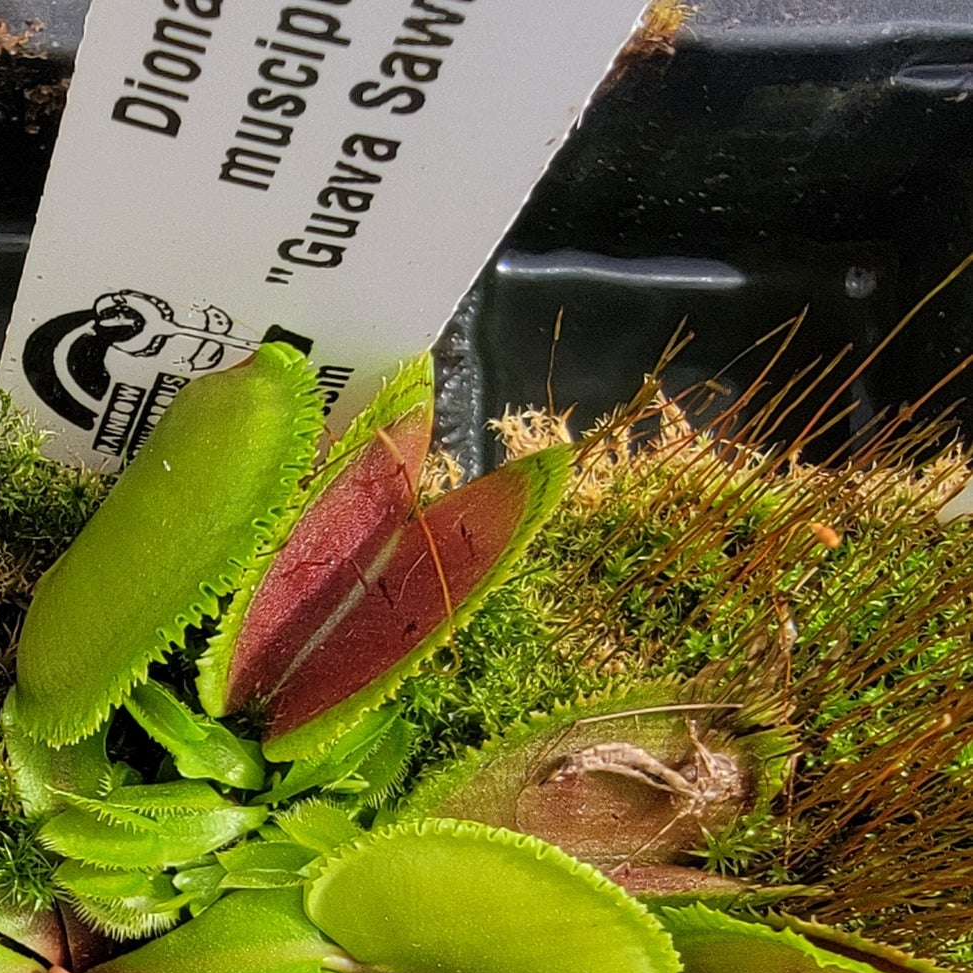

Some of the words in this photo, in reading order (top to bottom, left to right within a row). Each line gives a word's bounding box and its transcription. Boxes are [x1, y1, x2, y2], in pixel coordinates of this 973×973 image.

[218, 0, 352, 191] muscip
[265, 133, 402, 285] "Guava
[349, 0, 474, 115] Saw
[94, 383, 143, 456] RAINBOW
